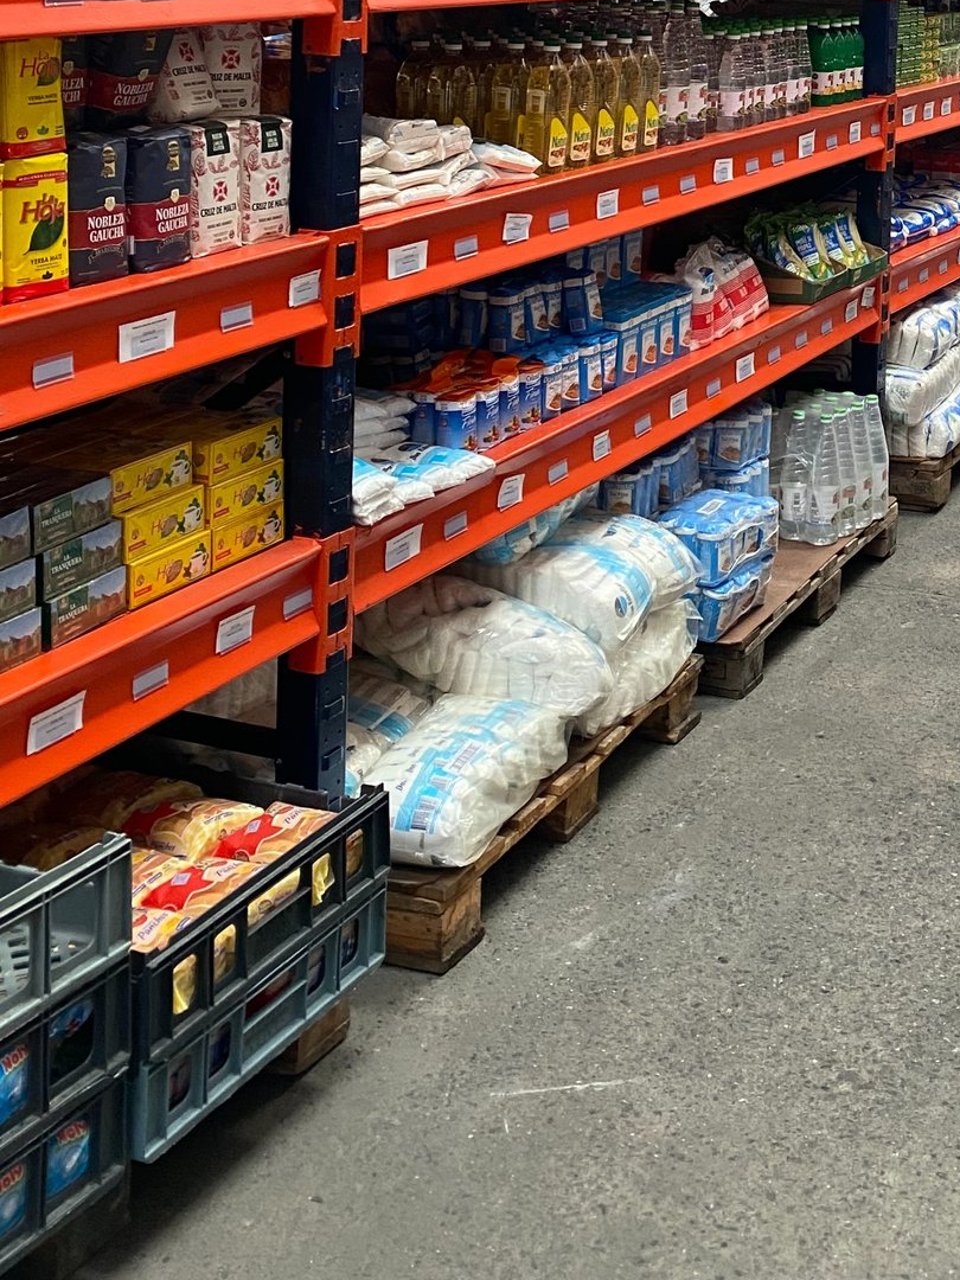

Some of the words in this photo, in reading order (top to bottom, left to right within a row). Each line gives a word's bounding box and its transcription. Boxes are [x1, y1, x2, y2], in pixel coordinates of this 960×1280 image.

[224, 72, 232, 80] DE
[233, 71, 251, 81] MALTA
[114, 80, 154, 97] NOBLEZA
[113, 91, 151, 108] GAUCHA
[19, 199, 65, 225] Hoja
[155, 203, 190, 222] NOBLEZA
[200, 207, 216, 218] CRUZ
[216, 206, 223, 215] DE
[223, 202, 237, 213] MALTA
[252, 201, 268, 212] CRUZ
[268, 200, 275, 210] DE
[87, 212, 125, 232] NOBLEZA
[158, 218, 188, 234] GAUCHA
[89, 225, 125, 243] GAUCHA
